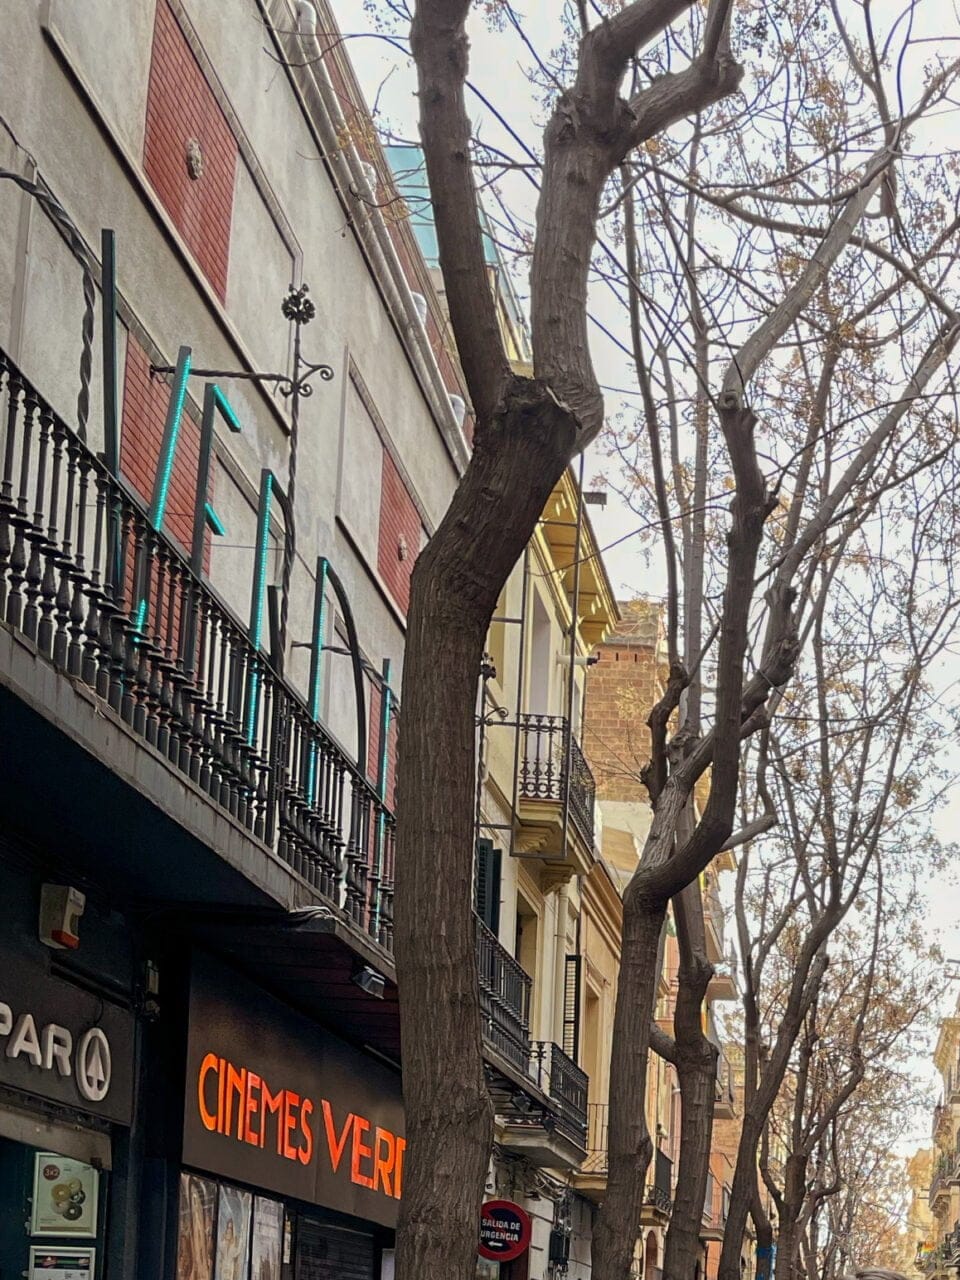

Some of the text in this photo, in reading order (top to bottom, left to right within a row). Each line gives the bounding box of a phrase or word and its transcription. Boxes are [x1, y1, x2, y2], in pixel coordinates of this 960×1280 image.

[198, 1052, 314, 1166] CINEMES
[482, 1218, 521, 1231] SALIDA DE
[480, 1230, 519, 1242] URGENCIA
